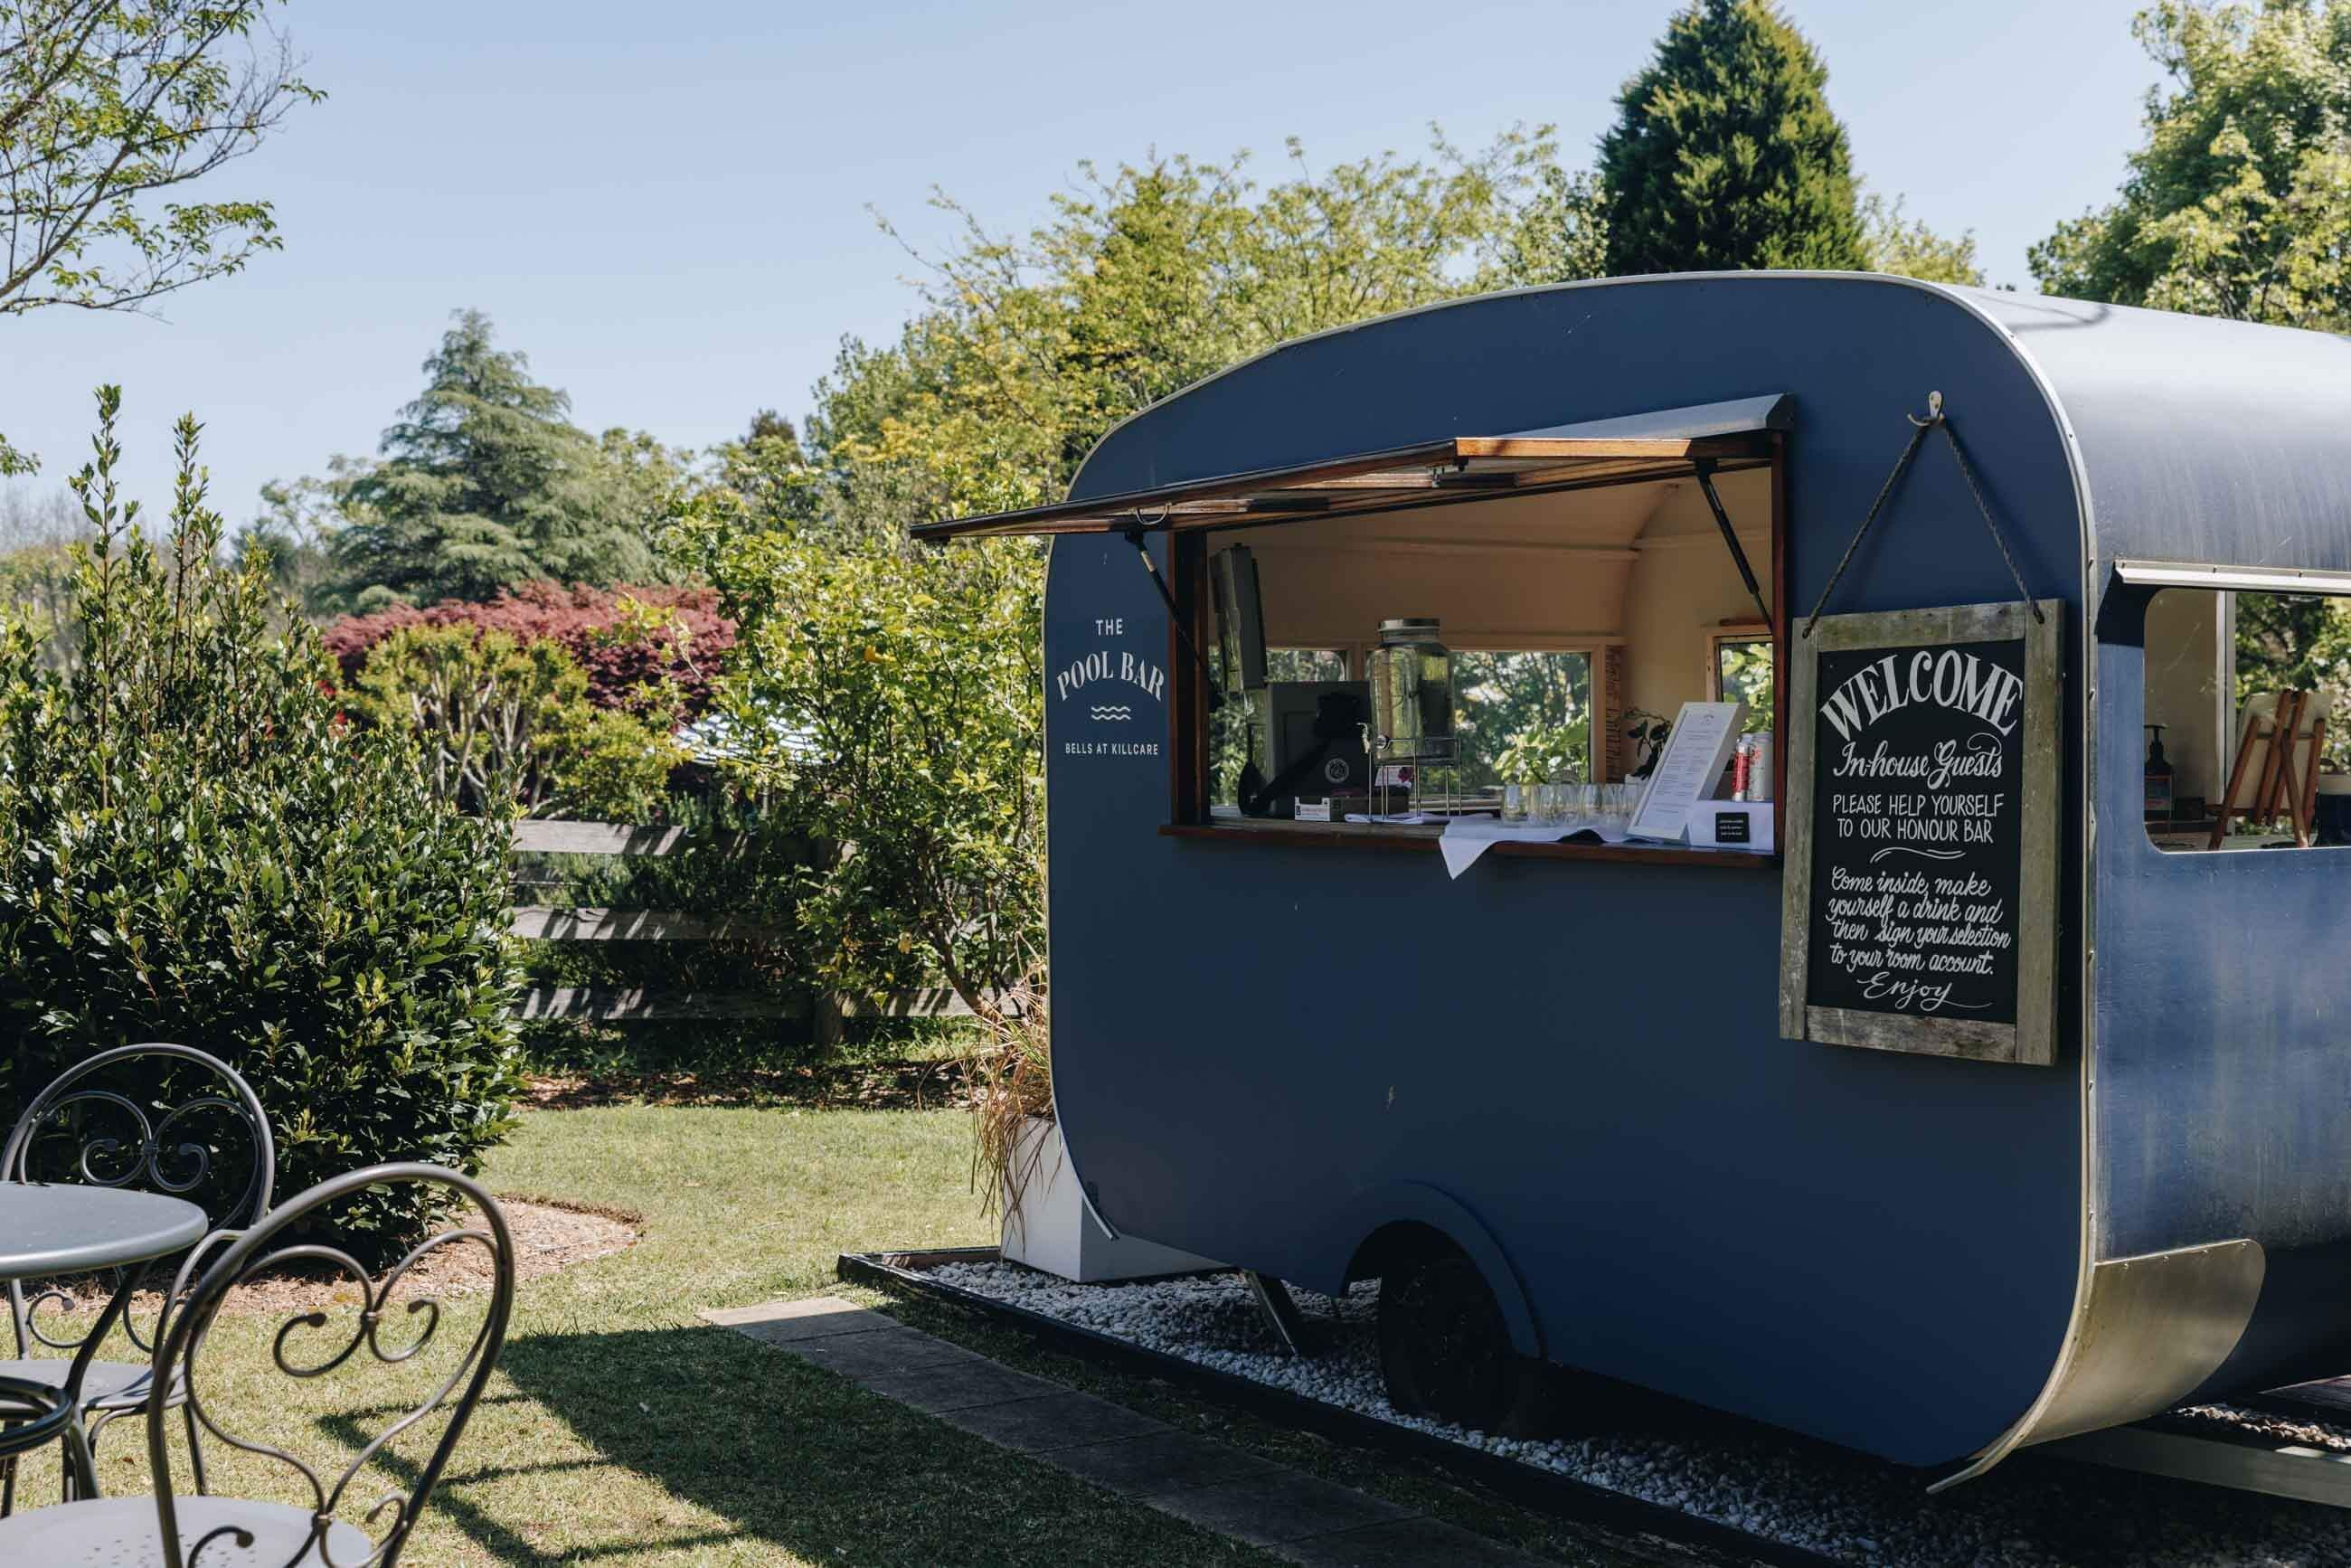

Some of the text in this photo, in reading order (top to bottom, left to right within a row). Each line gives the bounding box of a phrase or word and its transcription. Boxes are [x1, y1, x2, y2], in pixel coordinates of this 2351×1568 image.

[1096, 619, 1123, 636] THE
[1056, 651, 1165, 702] POOL BAR
[1819, 649, 2025, 741] WELCOME
[1065, 742, 1158, 755] BELLS AT KILLCARE
[1927, 732, 2004, 789] Guests
[1832, 793, 2005, 817] PLEASE HELP YOURSELF
[1837, 817, 1994, 843] TO OUR HONOUR BAR
[1831, 866, 1874, 892] Come
[1934, 872, 1992, 896] make
[1825, 894, 2004, 927] yourself a drink and
[1831, 919, 2012, 949] then sign your selection
[1830, 942, 1995, 975] to your room account.
[1856, 971, 1993, 1012] Enjoy
